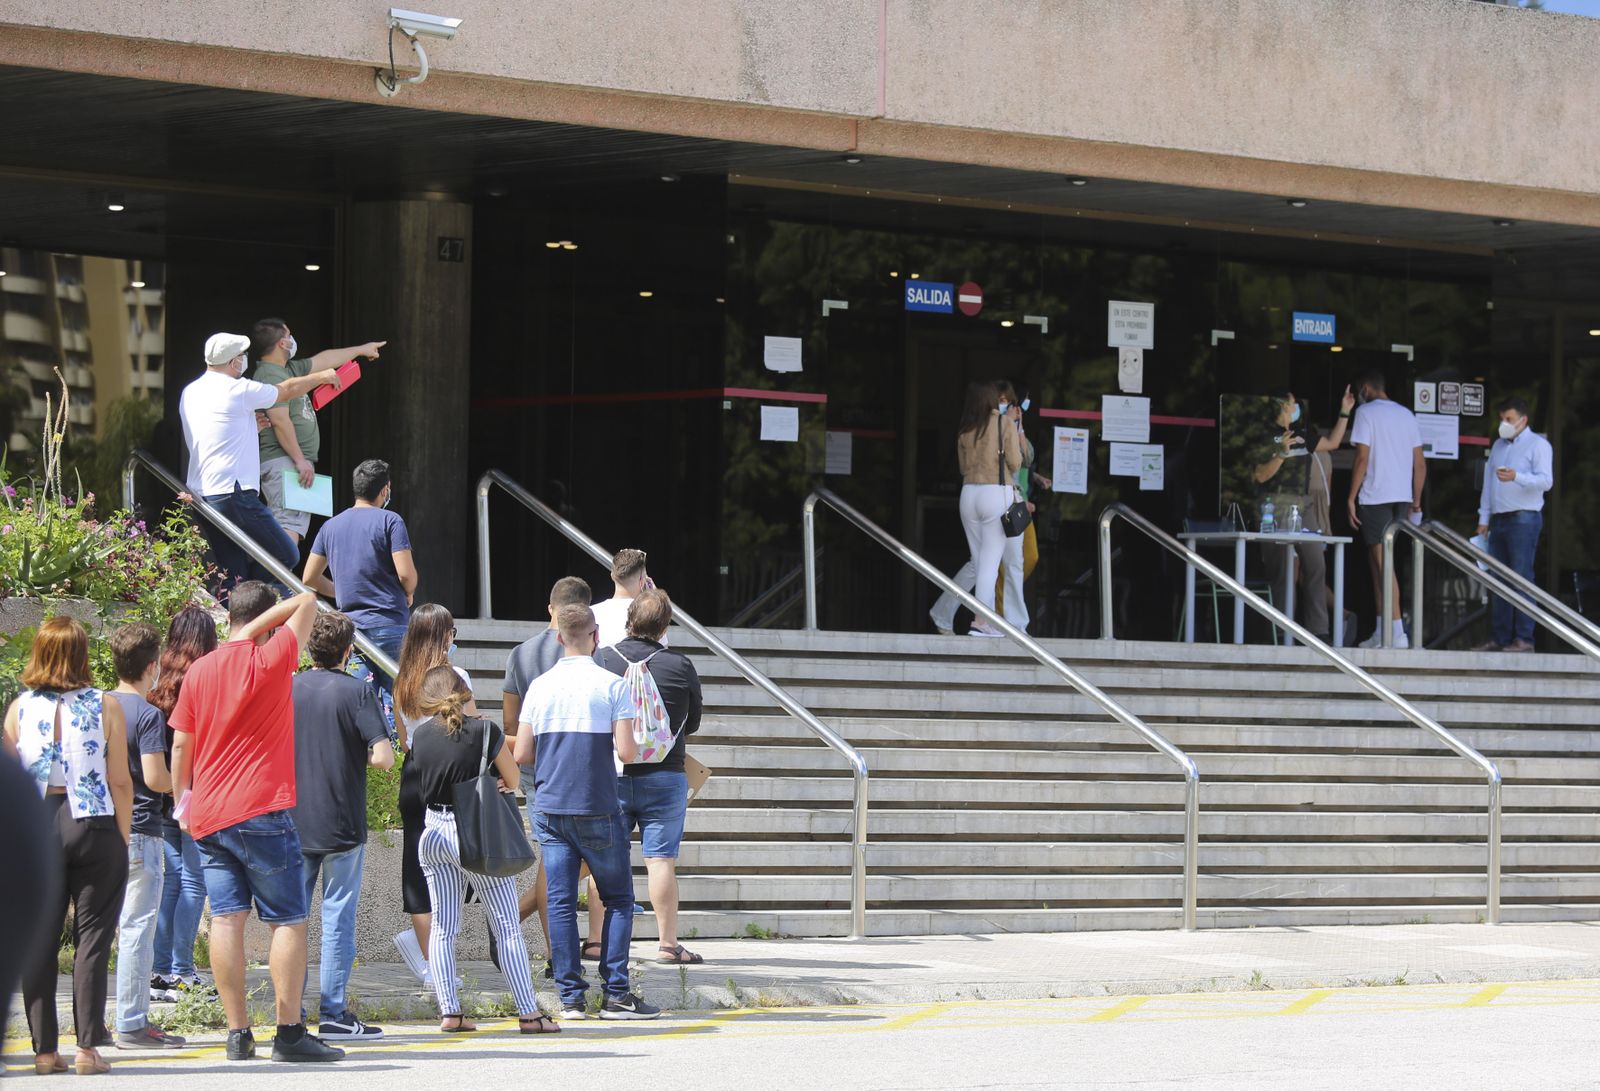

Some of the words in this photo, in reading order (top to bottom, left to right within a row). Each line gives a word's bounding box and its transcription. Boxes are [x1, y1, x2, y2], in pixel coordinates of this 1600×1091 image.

[440, 239, 463, 260] 47
[907, 287, 952, 306] SALIDA
[1295, 318, 1333, 336] ENTRADA
